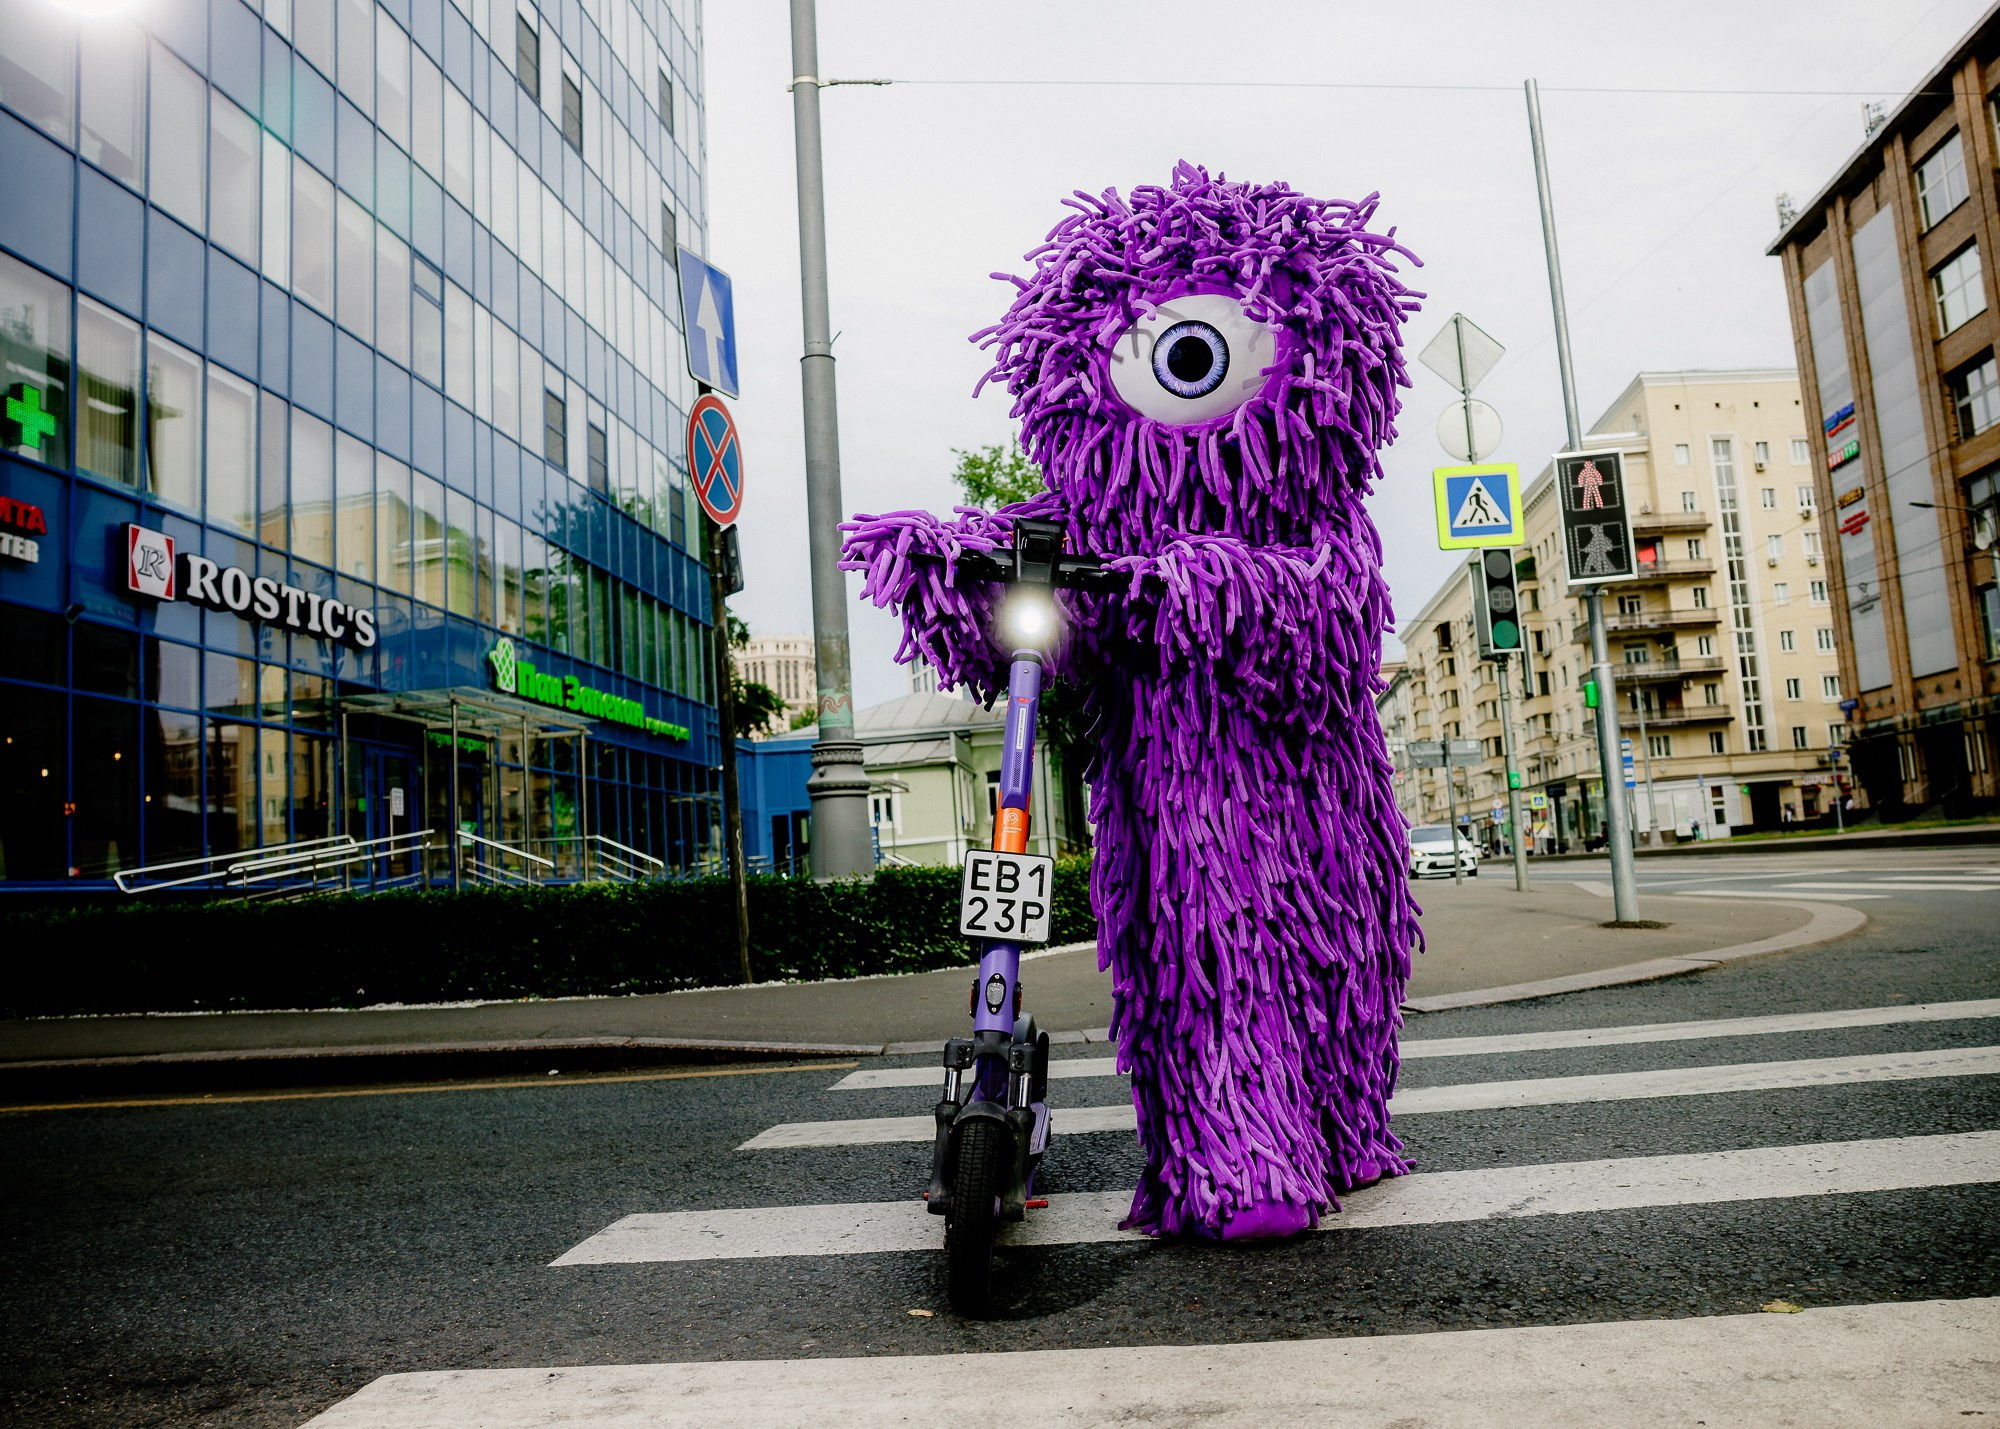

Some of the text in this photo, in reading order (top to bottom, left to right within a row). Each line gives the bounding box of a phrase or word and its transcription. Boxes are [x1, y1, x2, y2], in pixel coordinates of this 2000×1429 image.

[186, 553, 376, 647] ROSTIC'S
[517, 660, 645, 728] Пан Запекан
